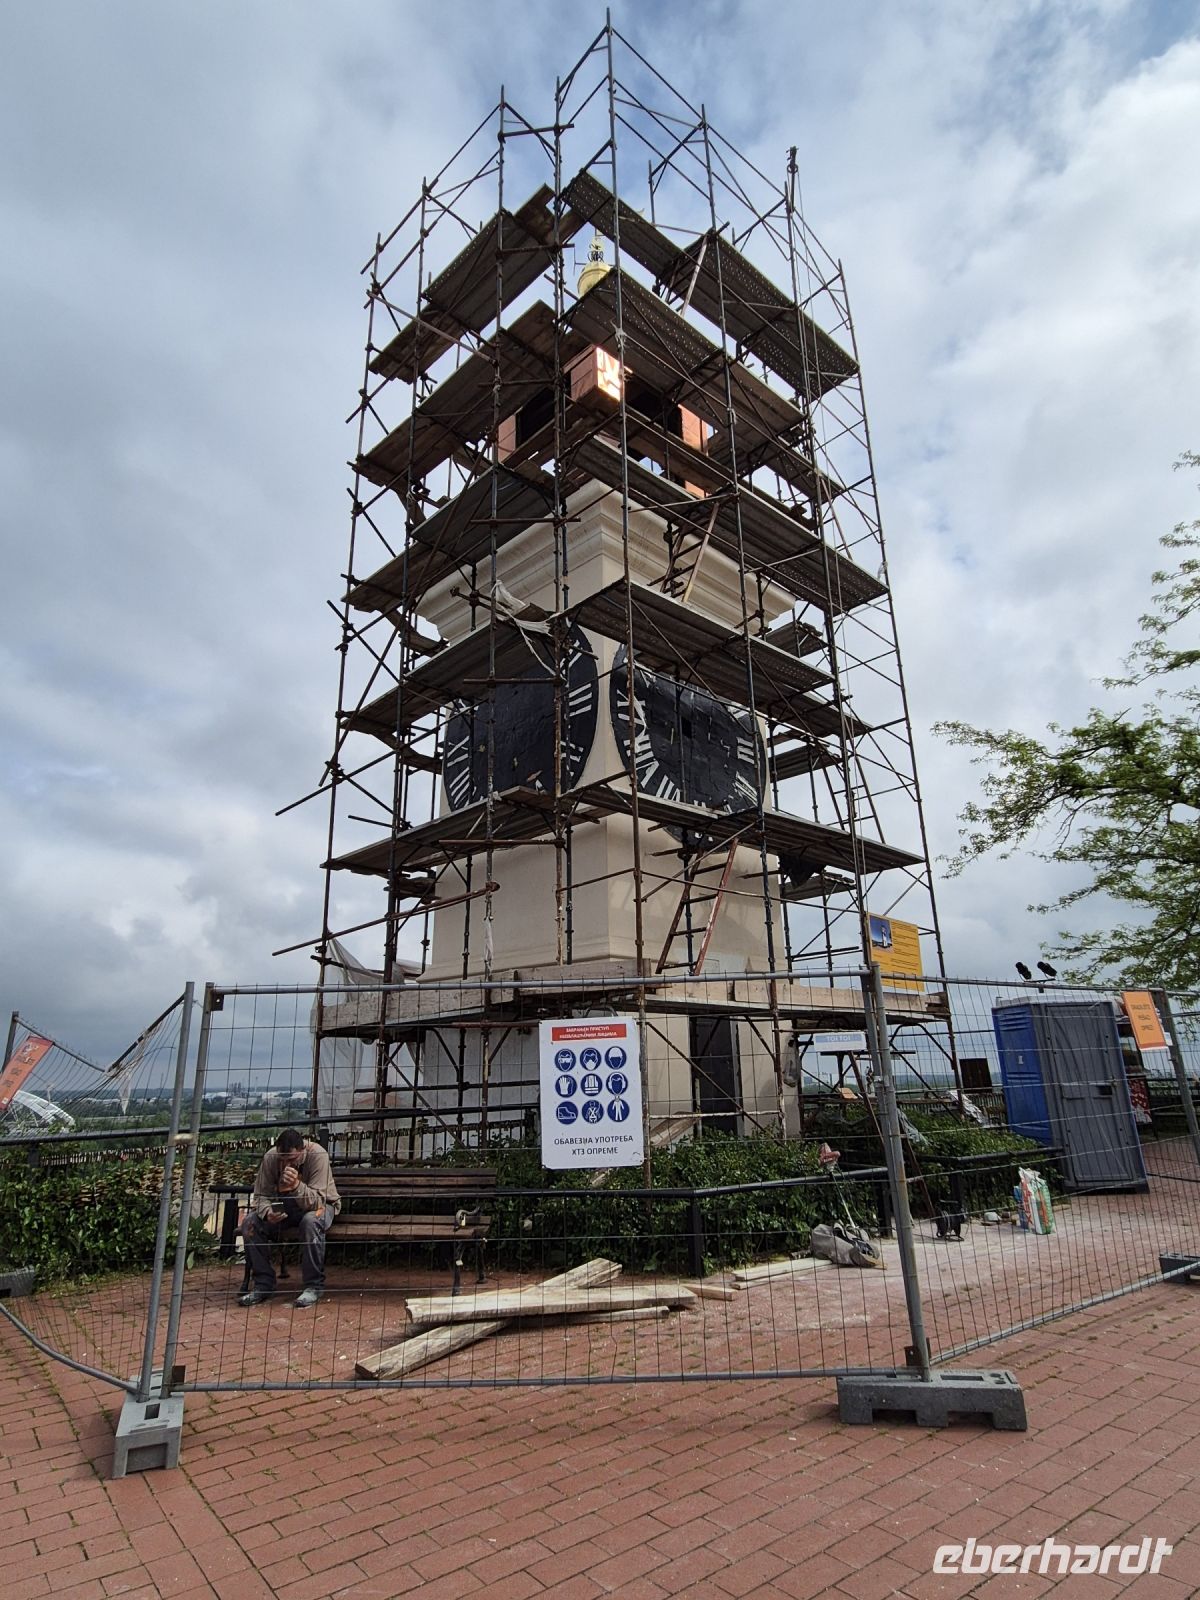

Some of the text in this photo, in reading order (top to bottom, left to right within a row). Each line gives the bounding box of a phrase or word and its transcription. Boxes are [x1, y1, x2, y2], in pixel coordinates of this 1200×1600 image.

[554, 1135, 634, 1145] ОБАВЕЗНА УПОТРЕБА
[572, 1147, 619, 1156] ХТЗ ОПРЕМЕ
